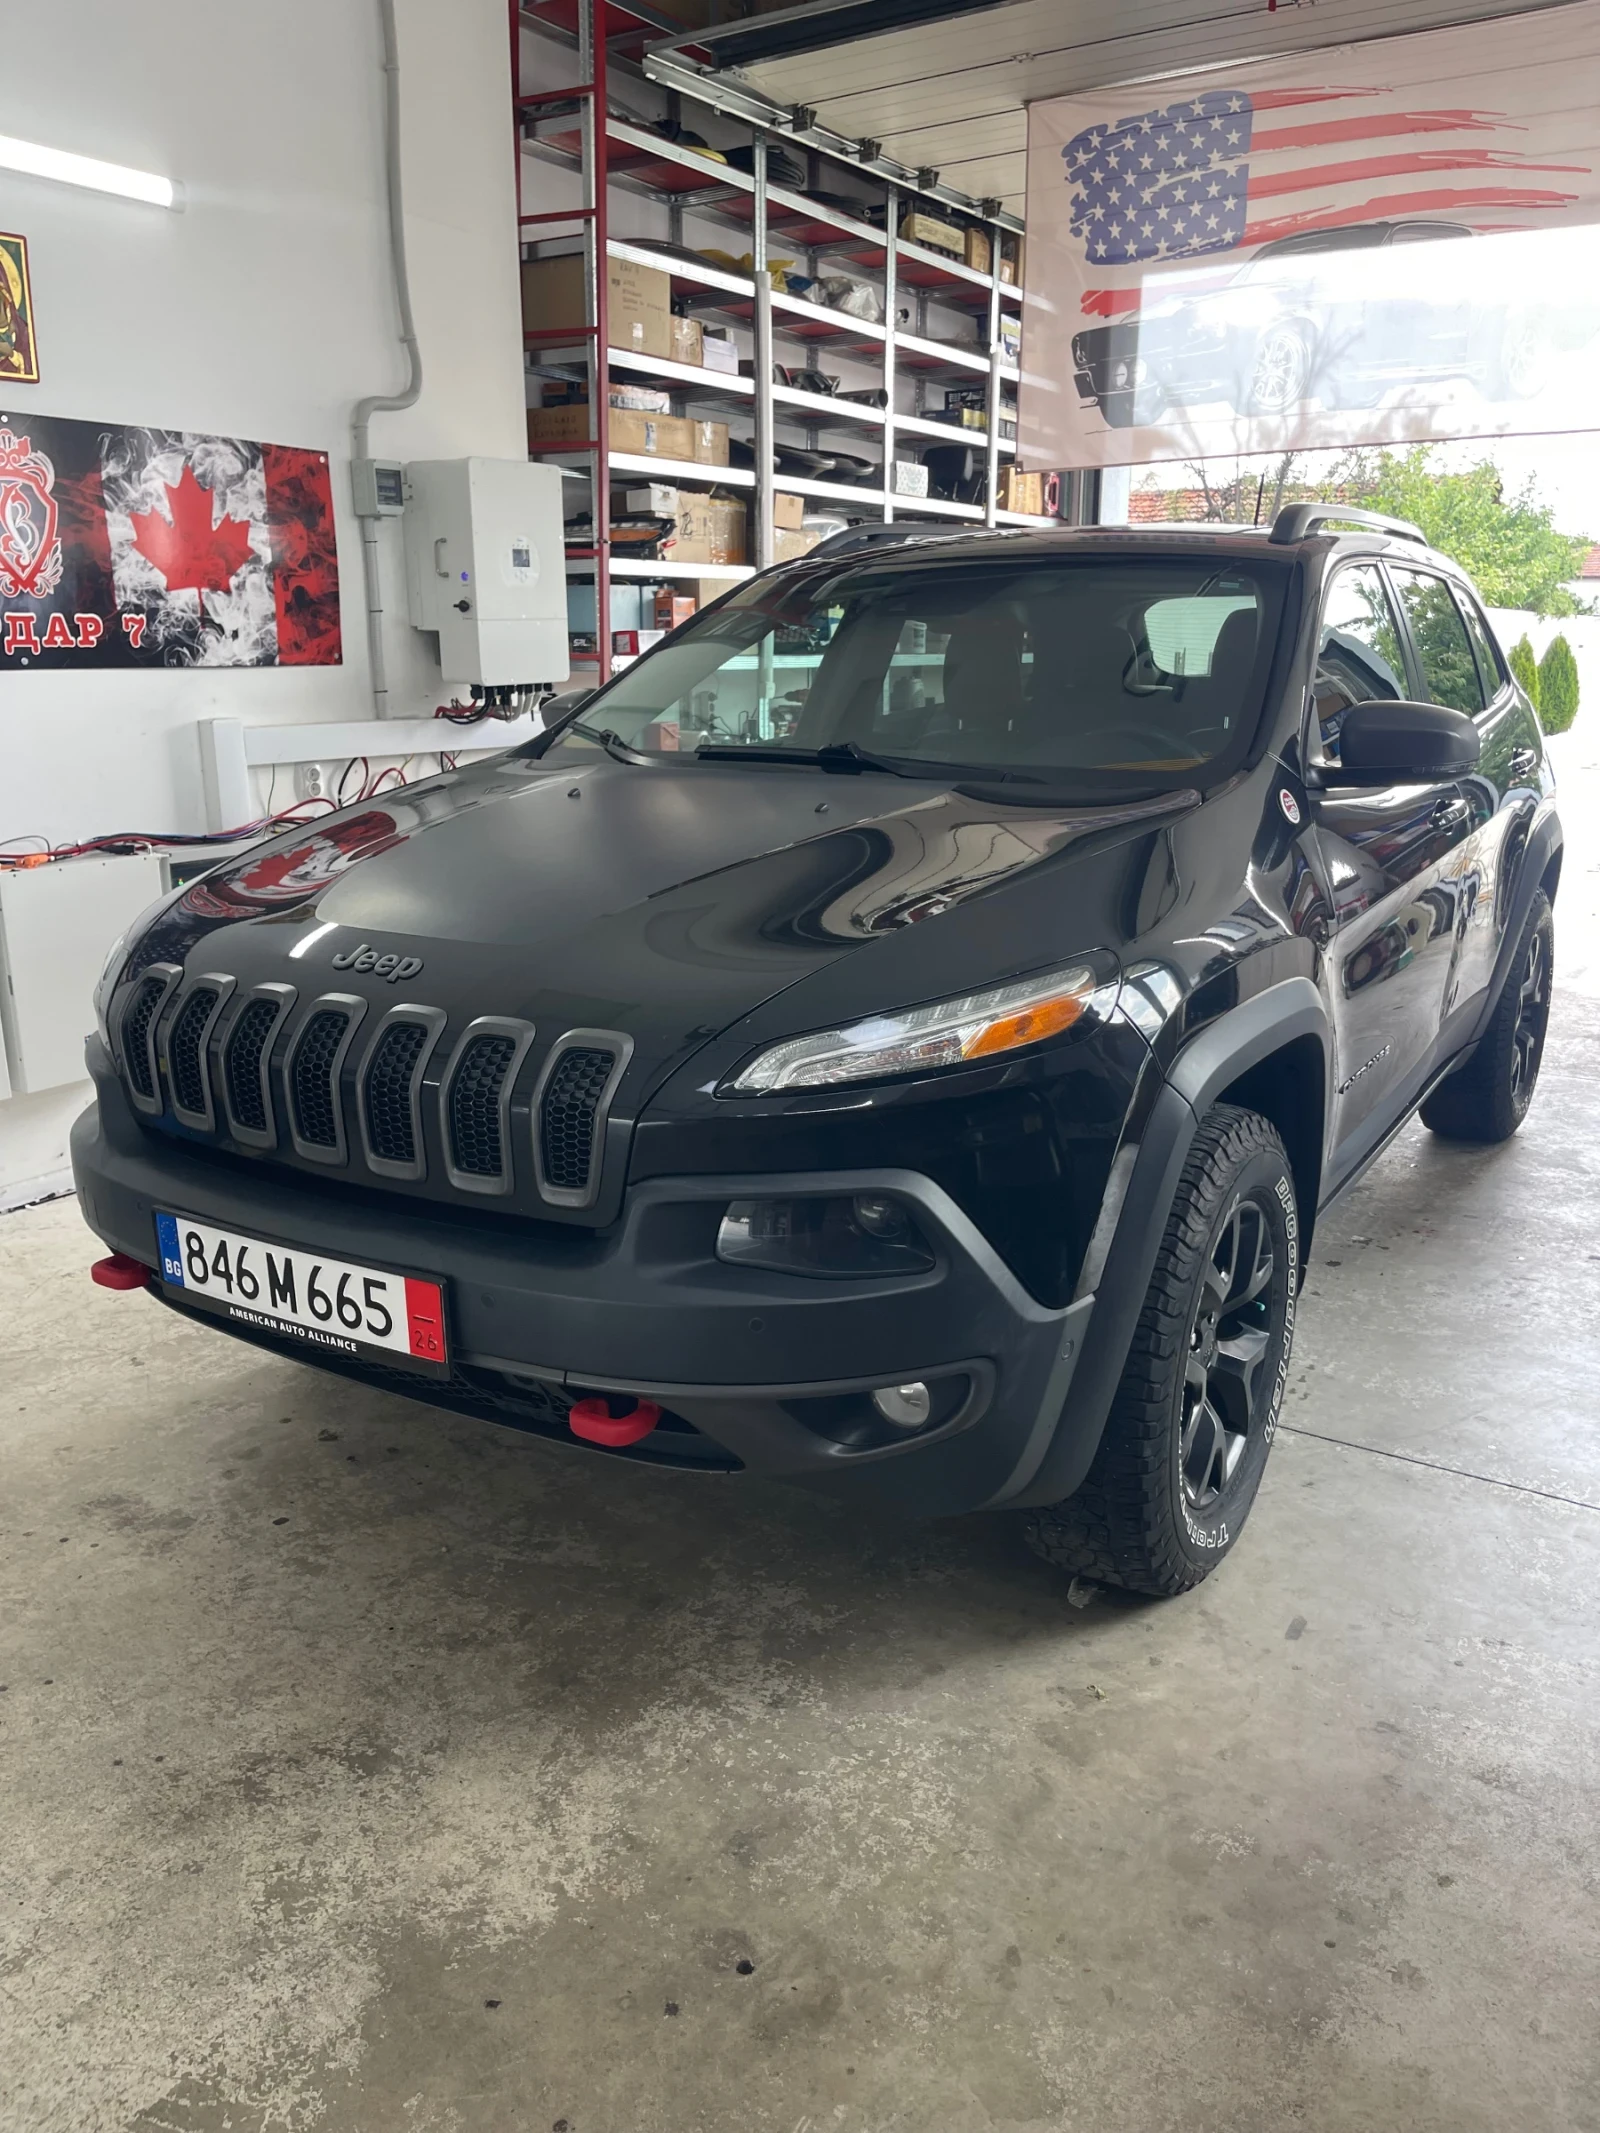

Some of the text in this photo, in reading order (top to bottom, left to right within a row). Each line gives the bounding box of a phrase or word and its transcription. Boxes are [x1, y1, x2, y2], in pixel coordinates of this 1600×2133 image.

[0, 611, 146, 655] ДАР 7
[331, 943, 424, 984] Jeep
[165, 1257, 182, 1277] BG
[185, 1231, 393, 1337] 846 M 665
[229, 1307, 357, 1352] AMERICAN AUTO ALLIANCE
[414, 1329, 437, 1351] 26
